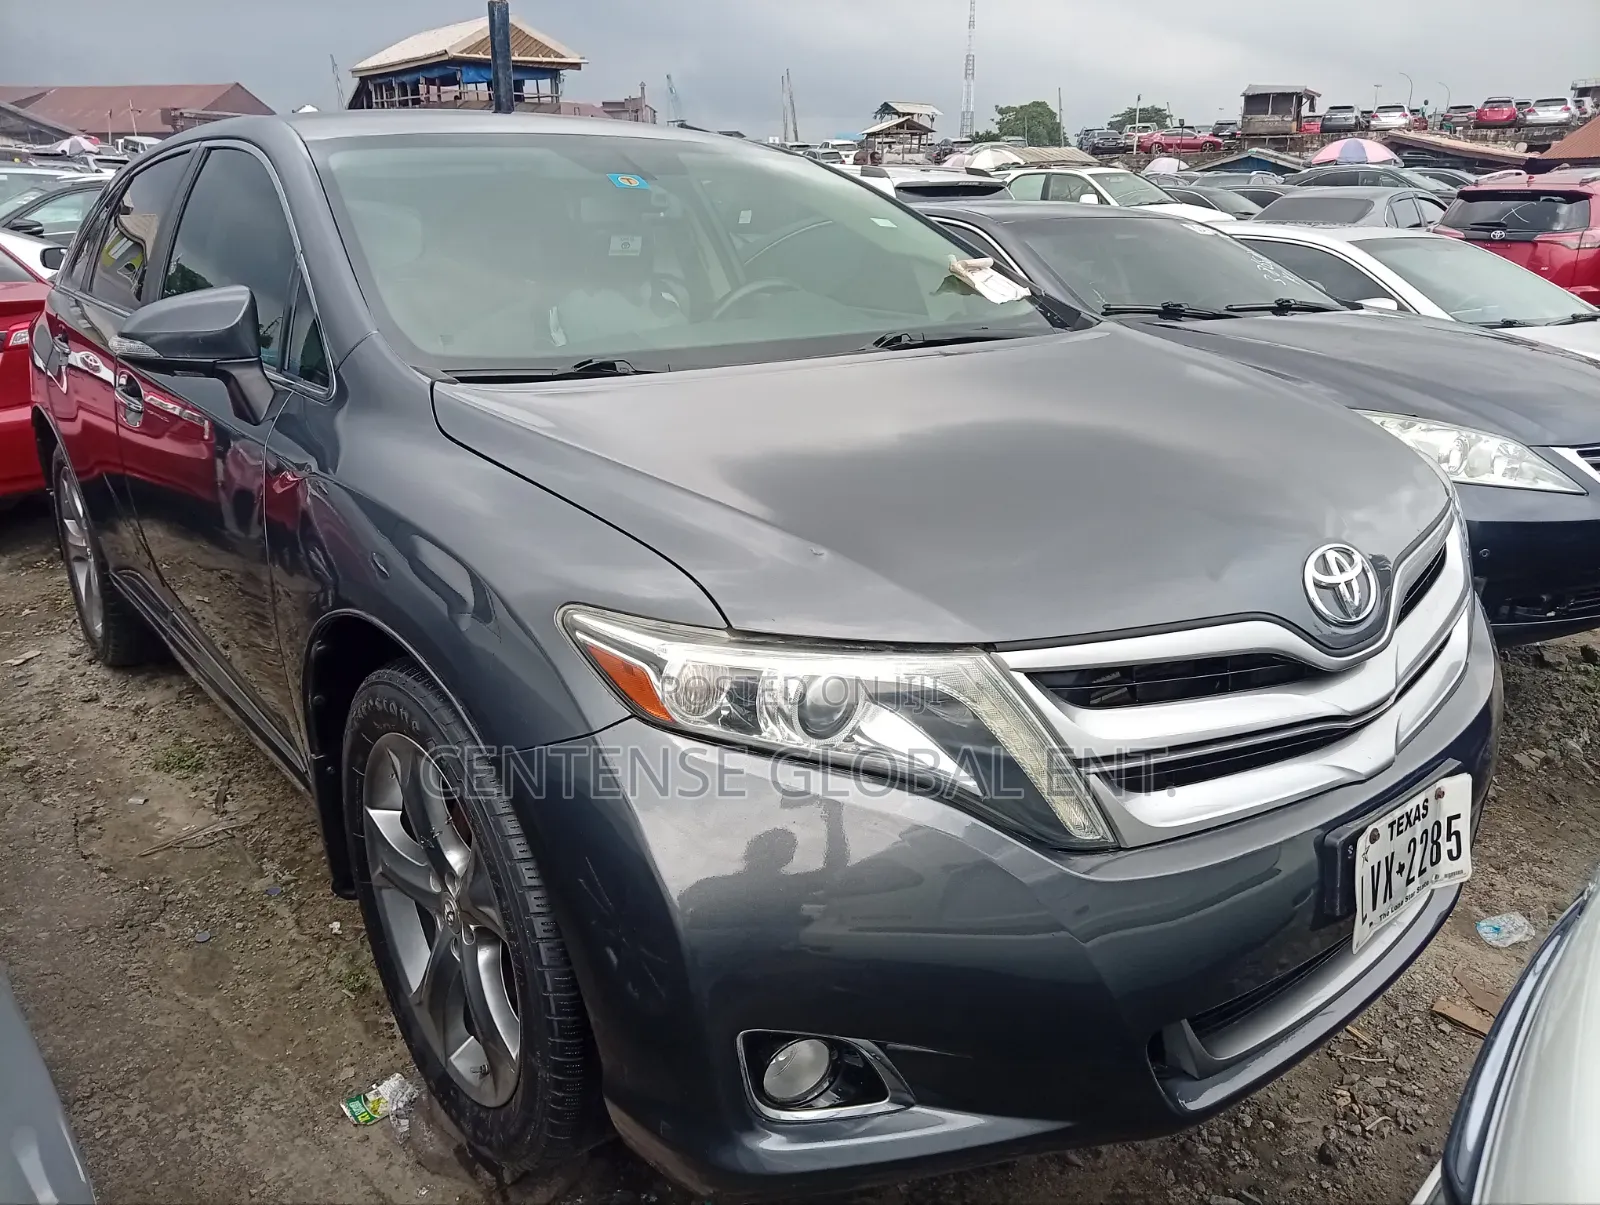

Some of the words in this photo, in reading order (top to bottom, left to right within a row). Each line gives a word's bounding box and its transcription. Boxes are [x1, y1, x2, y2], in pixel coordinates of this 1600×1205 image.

[1388, 798, 1429, 841] TEXAS
[1405, 813, 1462, 887] 2285
[1379, 910, 1390, 921] The
[1391, 900, 1404, 913] Lone
[1405, 891, 1416, 903] Star
[1416, 880, 1430, 894] State
